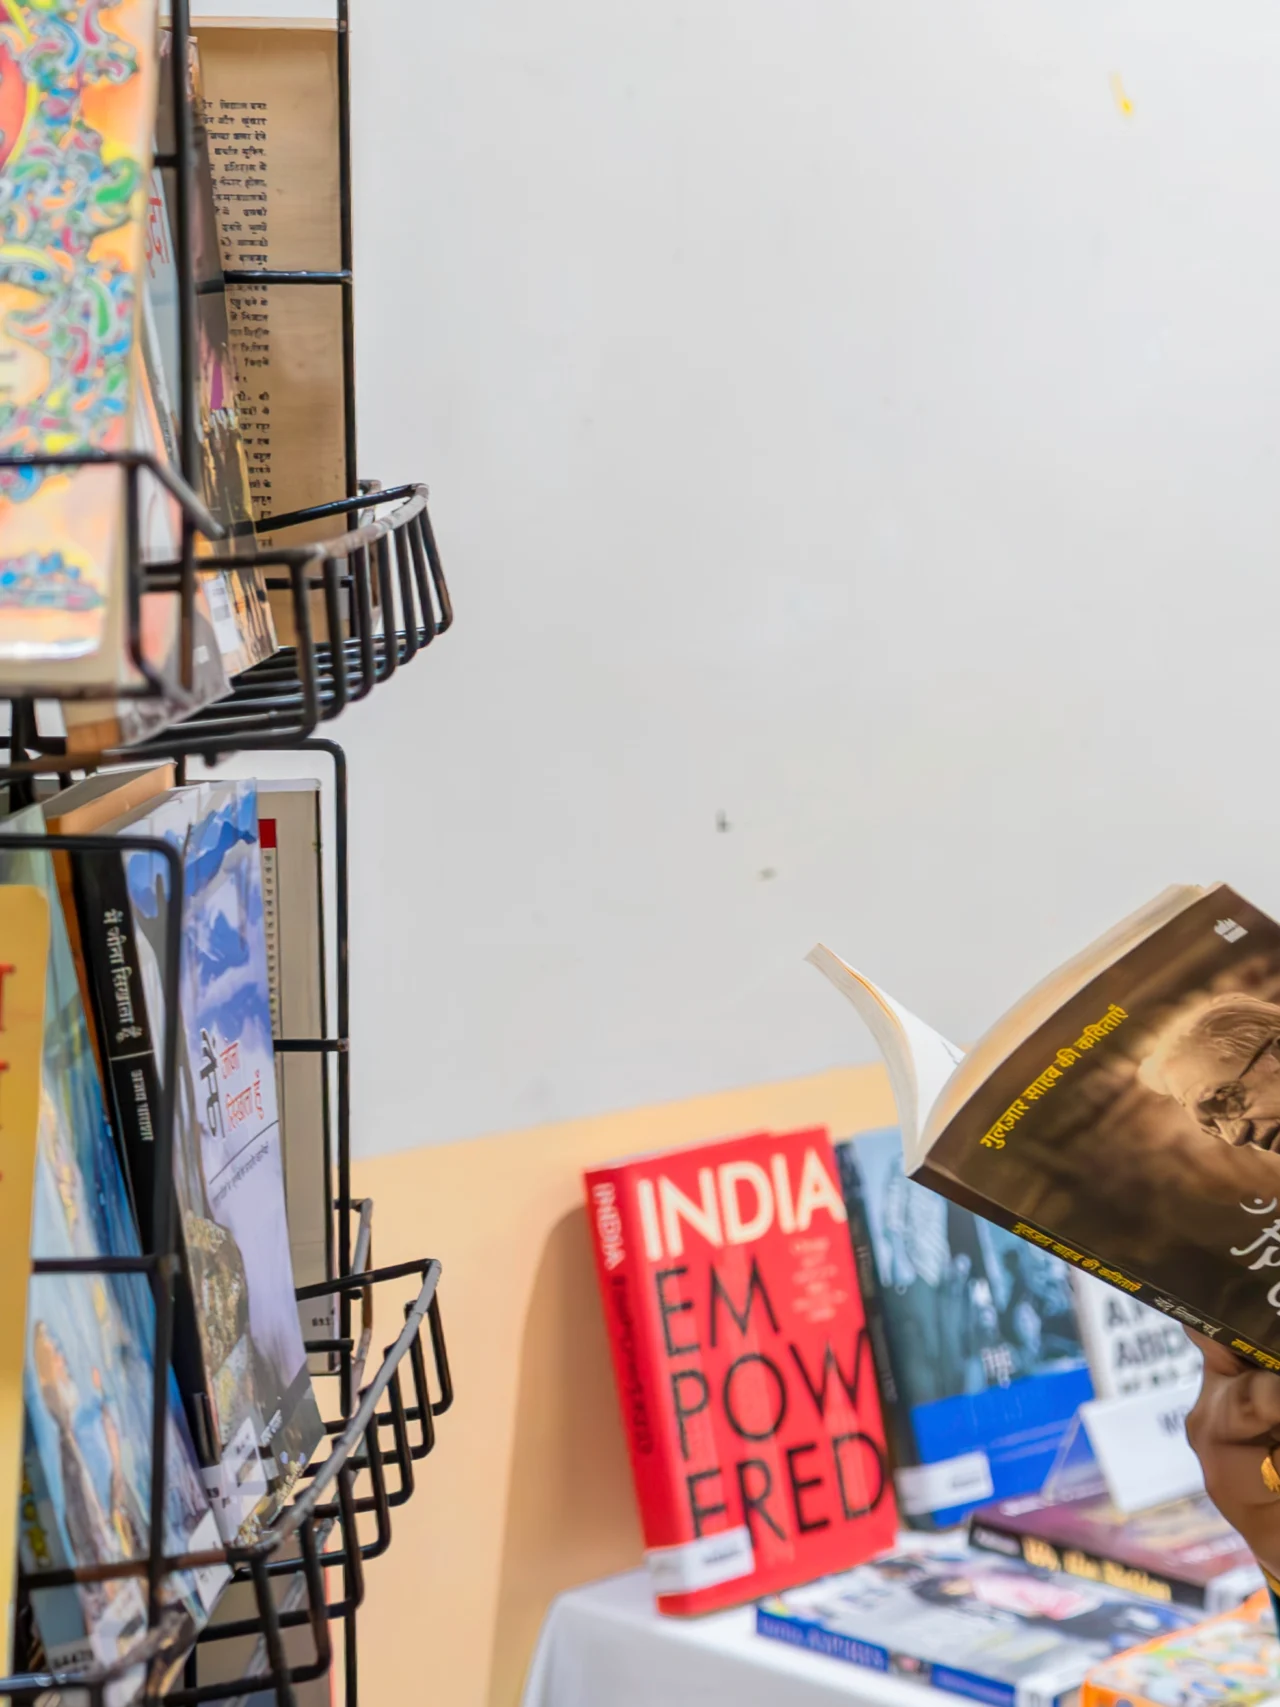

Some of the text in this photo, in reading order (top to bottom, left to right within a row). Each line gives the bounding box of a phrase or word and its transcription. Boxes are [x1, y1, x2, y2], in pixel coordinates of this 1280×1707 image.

[103, 907, 123, 925] मैं
[106, 926, 127, 964] जीना
[979, 1003, 1129, 1150] गुलज़ार साहब की कविताएँ
[592, 1182, 627, 1271] INDIA
[637, 1147, 849, 1262] INDIA
[656, 1254, 781, 1358] EM
[670, 1327, 870, 1462] POW
